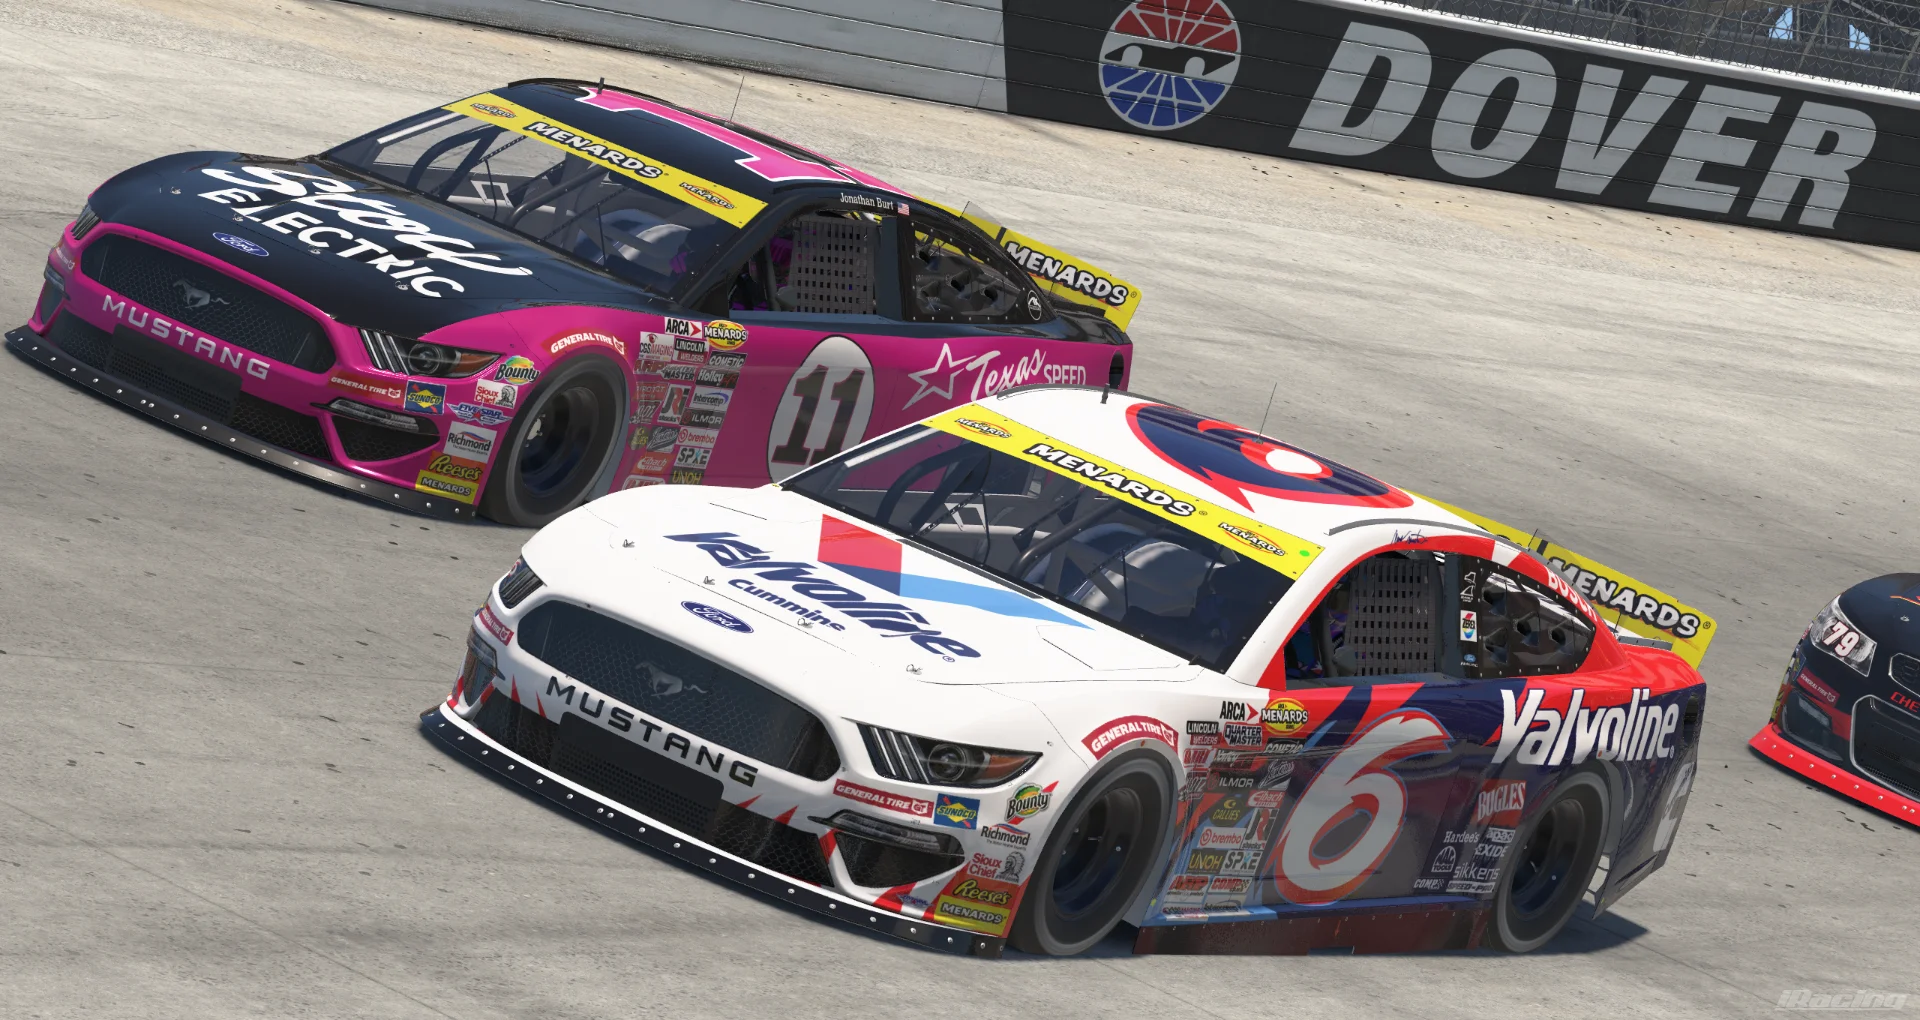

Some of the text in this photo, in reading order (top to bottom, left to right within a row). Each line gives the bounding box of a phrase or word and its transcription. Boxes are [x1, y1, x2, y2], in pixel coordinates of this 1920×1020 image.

[470, 102, 517, 119] MENARDS
[1288, 20, 1878, 231] DOVER
[523, 121, 664, 179] MENARDS
[679, 181, 735, 210] MENARDS
[840, 192, 894, 210] Jonathan Burt
[198, 188, 465, 297] ELECTRIC
[1004, 241, 1130, 307] MENARDS
[666, 318, 690, 335] ARCA
[704, 325, 748, 341] MENARDS
[102, 294, 271, 380] MUSTANG
[550, 333, 614, 353] GENERAL TIRE
[676, 340, 705, 352] LINCOLN
[680, 352, 705, 363] WELDERS
[708, 354, 744, 367] COMETIC
[494, 363, 540, 384] Bounty
[664, 370, 694, 381] MASTER
[698, 370, 724, 385] Holley
[965, 348, 1047, 403] Texas
[1043, 363, 1087, 386] SPEED
[331, 376, 387, 395] GENERAL TIRE
[477, 385, 499, 398] Sioux
[408, 393, 443, 405] SUNOCO
[458, 403, 478, 413] FIVE
[475, 394, 498, 405] Chief
[692, 414, 723, 425] ILMOR
[771, 364, 863, 465] 11
[687, 430, 716, 443] brembo
[955, 417, 1012, 439] MENARDS
[448, 432, 492, 452] Richmond
[430, 455, 483, 481] Reese's
[421, 477, 472, 496] MENARDS
[1022, 443, 1196, 518] MENARDS
[1218, 522, 1286, 556] MENARDS
[662, 532, 982, 659] Valvoline
[1549, 557, 1700, 638] MENARDS
[727, 579, 846, 632] Cummins
[690, 603, 745, 631] Ford
[1823, 620, 1860, 657] 79
[1220, 700, 1245, 721] ARCA
[1261, 708, 1309, 723] MENARDS
[545, 675, 759, 788] MUSTANG
[1187, 721, 1217, 734] LINCOLN
[1225, 724, 1262, 737] QUARTER
[1491, 689, 1681, 767] Valvoline
[1091, 722, 1162, 753] GENERAL TIRE
[1193, 734, 1218, 745] WELDERS
[1229, 733, 1262, 746] MASTER
[1218, 776, 1254, 788] ILMOR
[836, 784, 885, 805] GENERAL
[885, 797, 911, 810] TIRE
[1006, 791, 1050, 817] Bounty
[1274, 706, 1455, 905] 6
[1477, 782, 1526, 822] BUGLES
[938, 806, 976, 819] SUNOCO
[1212, 809, 1240, 821] CALLIES
[981, 826, 1031, 847] Richmond
[1211, 831, 1242, 844] brembo
[1443, 831, 1480, 843] Hardee's
[972, 852, 1003, 868] Sioux
[1475, 844, 1508, 857] EXIDE
[970, 864, 998, 878] Chief
[1189, 854, 1223, 870] UNOH
[1453, 862, 1500, 880] sikkens
[953, 880, 1012, 906] Reese's
[941, 903, 1002, 924] MENARDS
